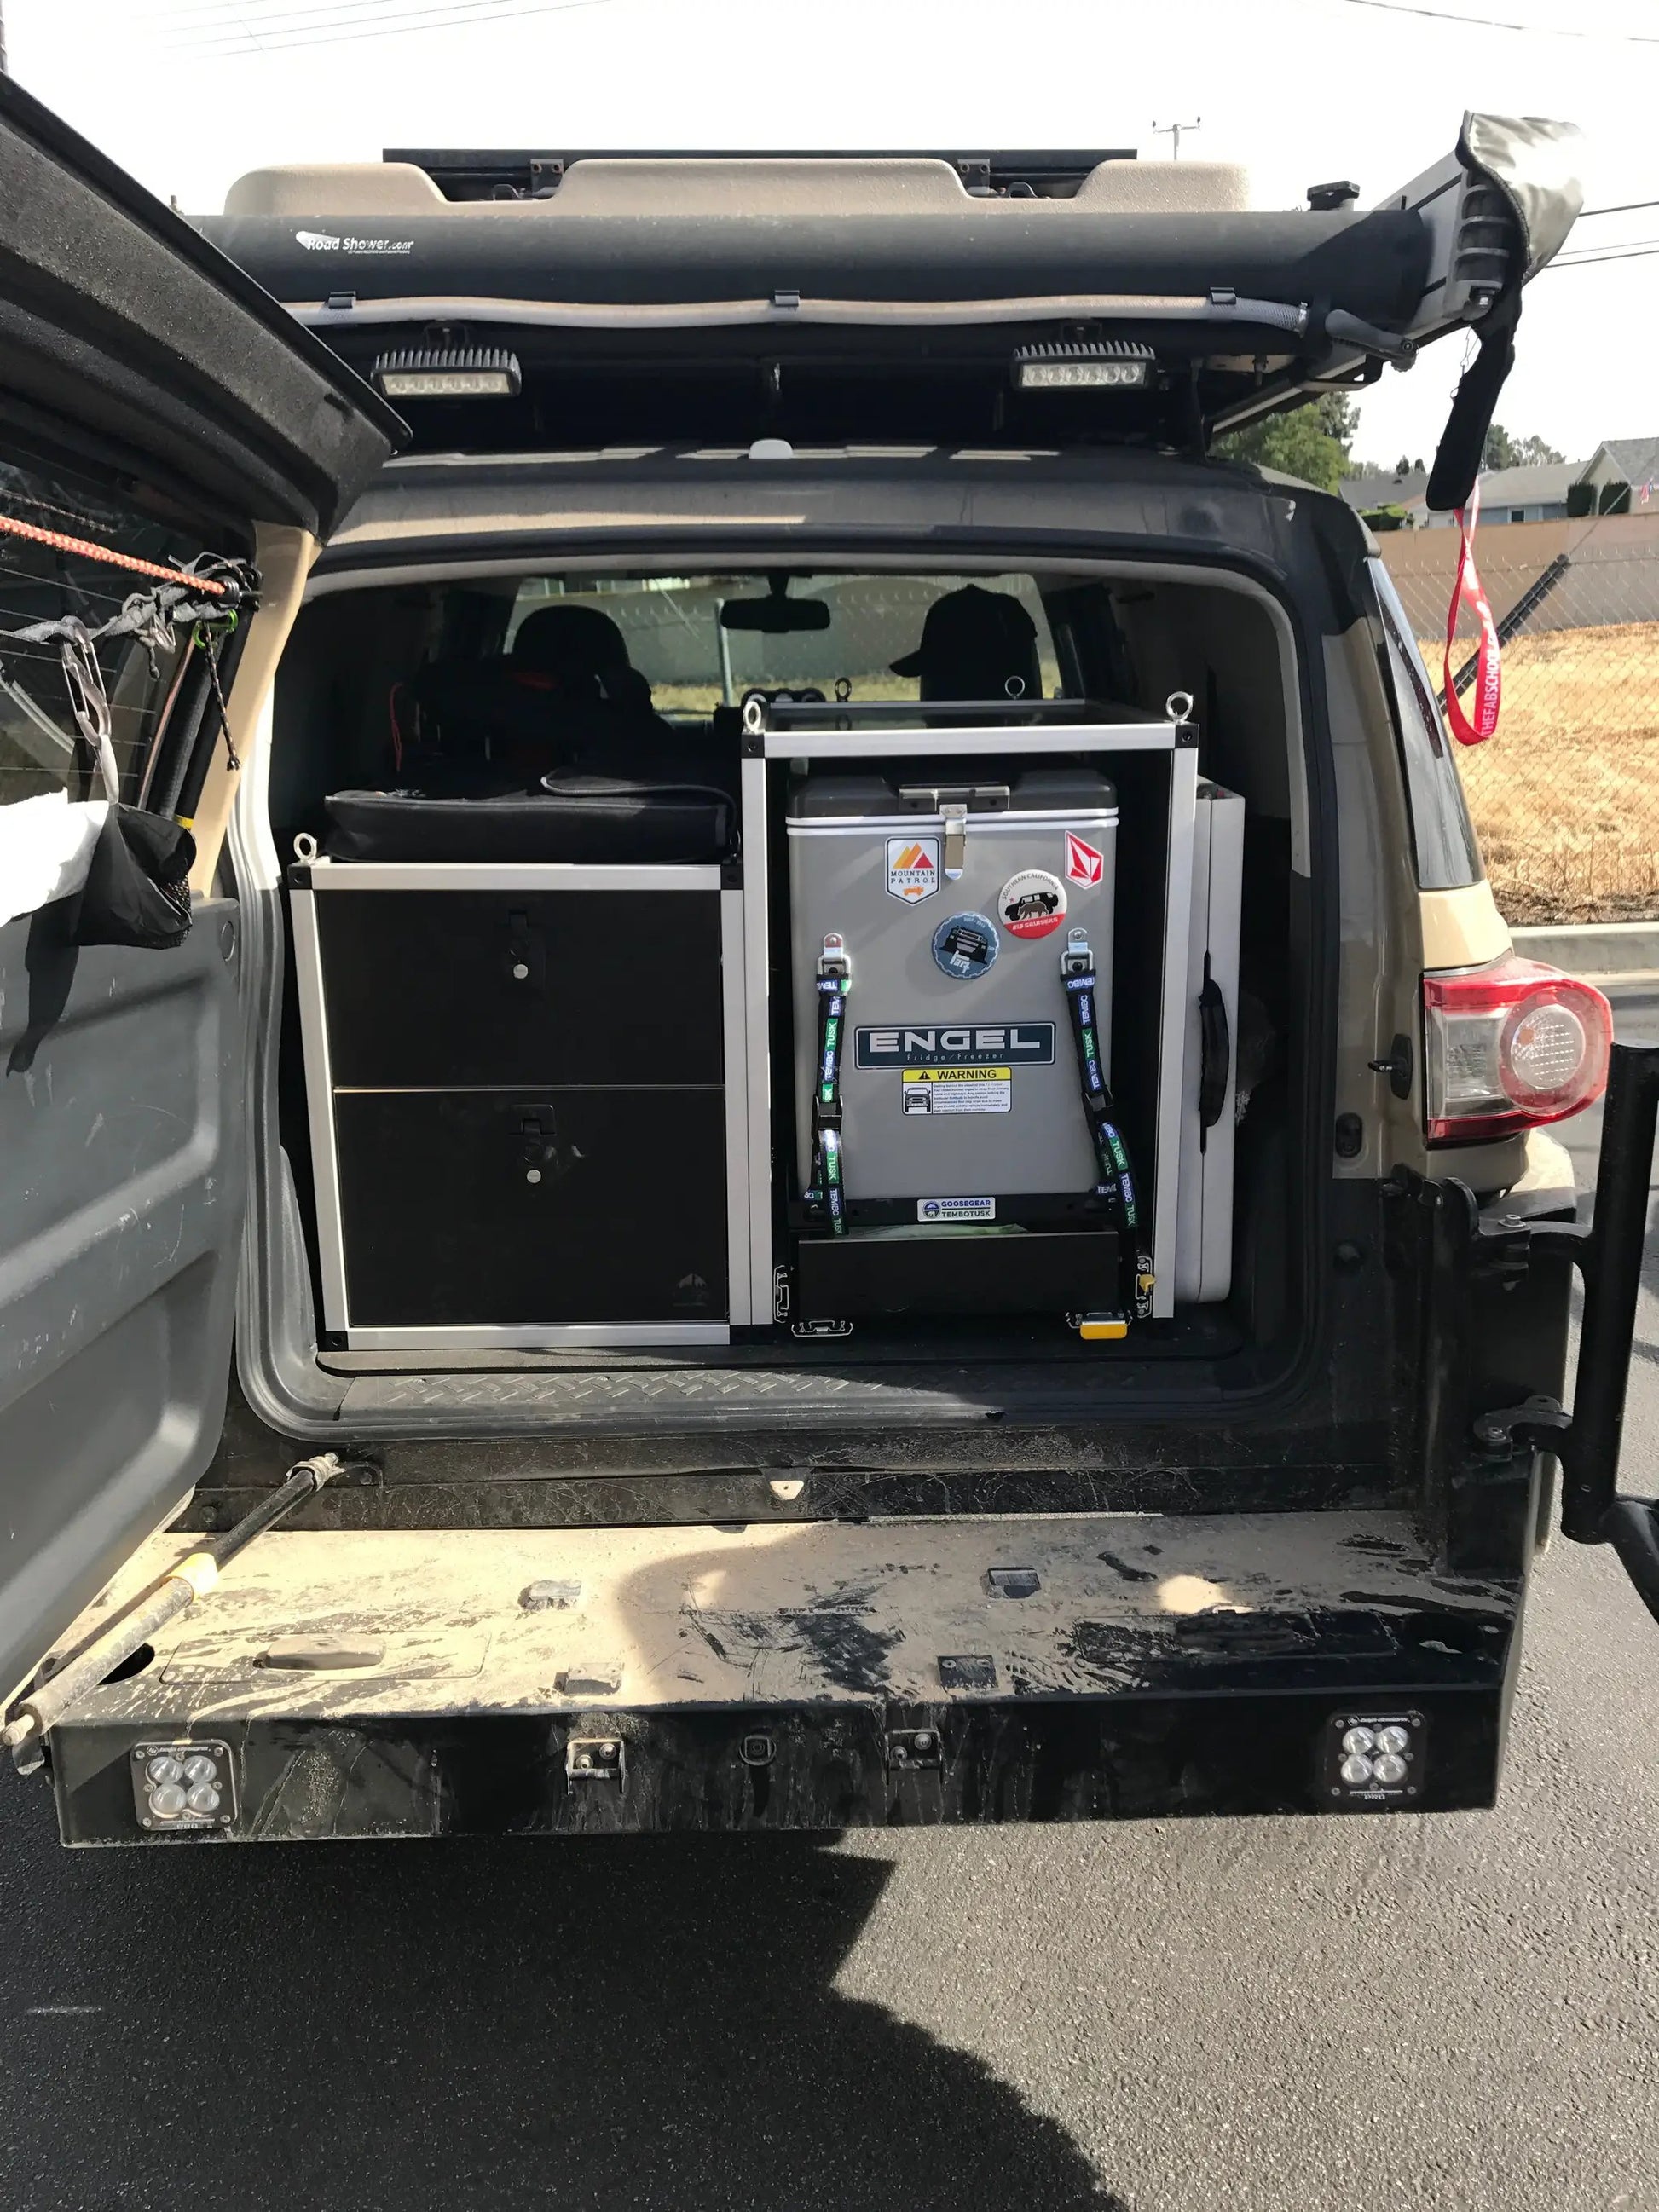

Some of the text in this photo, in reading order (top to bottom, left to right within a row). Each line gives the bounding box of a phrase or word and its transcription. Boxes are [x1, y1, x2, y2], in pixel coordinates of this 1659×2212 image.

[308, 238, 340, 250] Road
[1003, 875, 1026, 899] SOUTHERN
[1080, 995, 1090, 1025] TEMBO
[827, 1023, 837, 1047] TUSK
[870, 1029, 1040, 1053] ENGEL
[1084, 1033, 1094, 1058] TUSK
[906, 1054, 1004, 1062] Fridge/Freezer
[937, 1070, 997, 1080] WARNING
[1112, 1141, 1125, 1167] TUSK
[828, 1155, 836, 1181] TUSK
[1121, 1173, 1133, 1203] TEMBO
[830, 1188, 840, 1216] TEMBO
